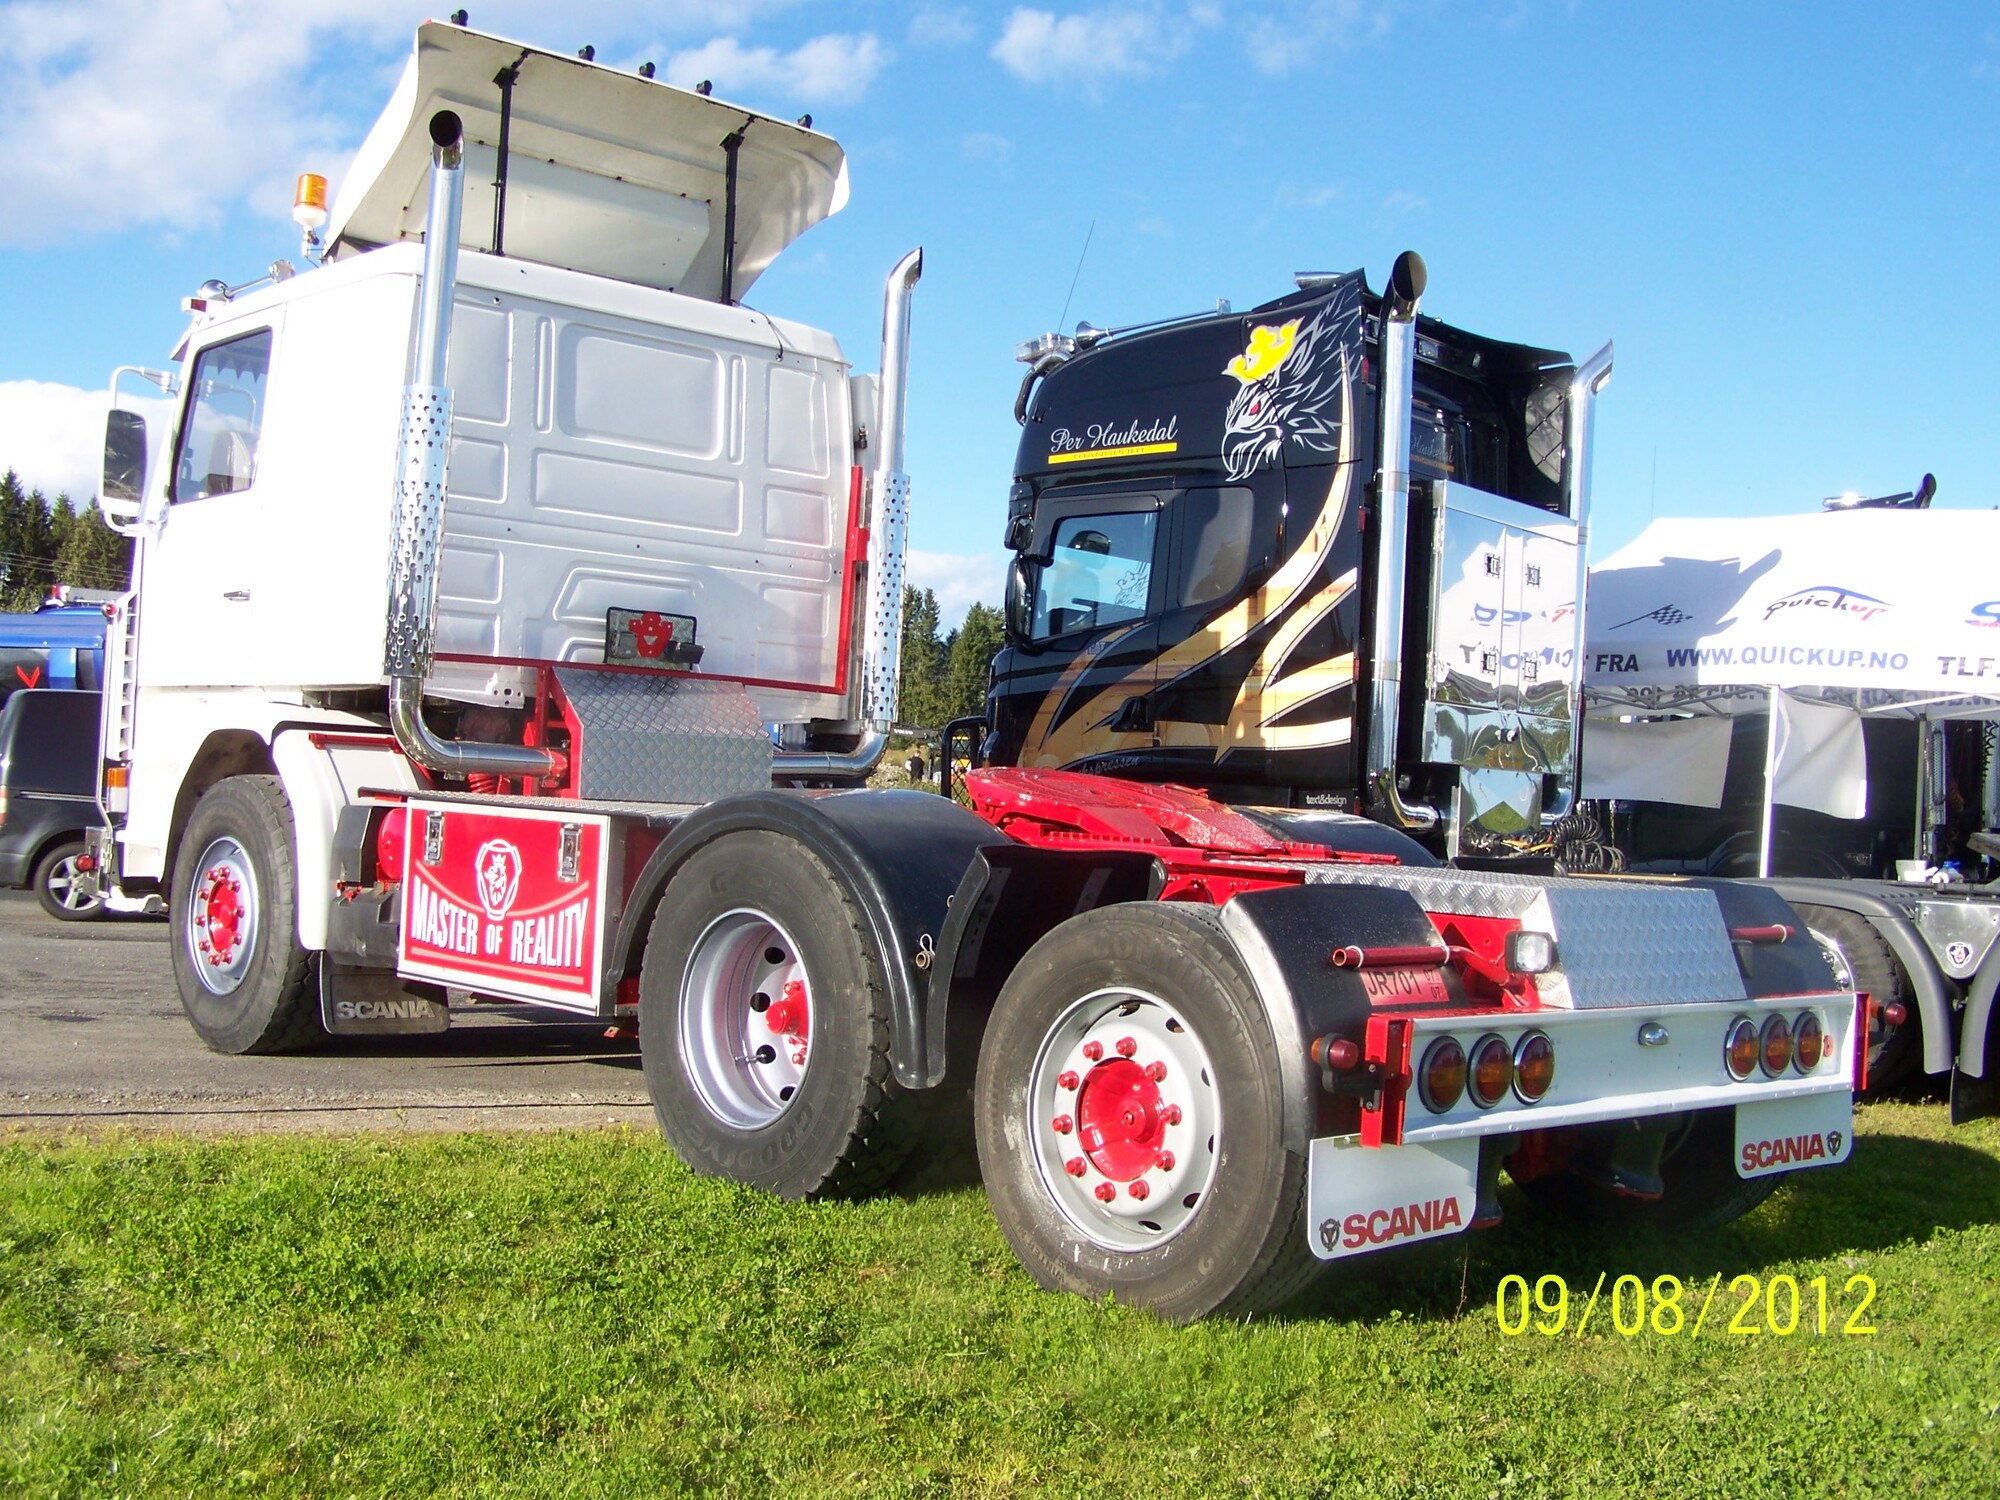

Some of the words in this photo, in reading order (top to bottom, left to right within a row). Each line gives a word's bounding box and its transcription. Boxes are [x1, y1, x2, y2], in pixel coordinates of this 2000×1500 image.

[1051, 428, 1084, 453] Per
[1087, 415, 1178, 448] Haukedal
[1595, 653, 1640, 672] FRA
[1666, 646, 1909, 671] WWW.QUICKUP.NO
[1306, 793, 1347, 807] text&design
[411, 875, 479, 956] MASTER
[485, 923, 504, 956] OF
[510, 897, 589, 969] REALITY
[1367, 969, 1422, 996] JR701
[336, 1000, 436, 1019] SCANIA
[1741, 1133, 1826, 1171] SCANIA
[1342, 1196, 1462, 1249] SCANIA
